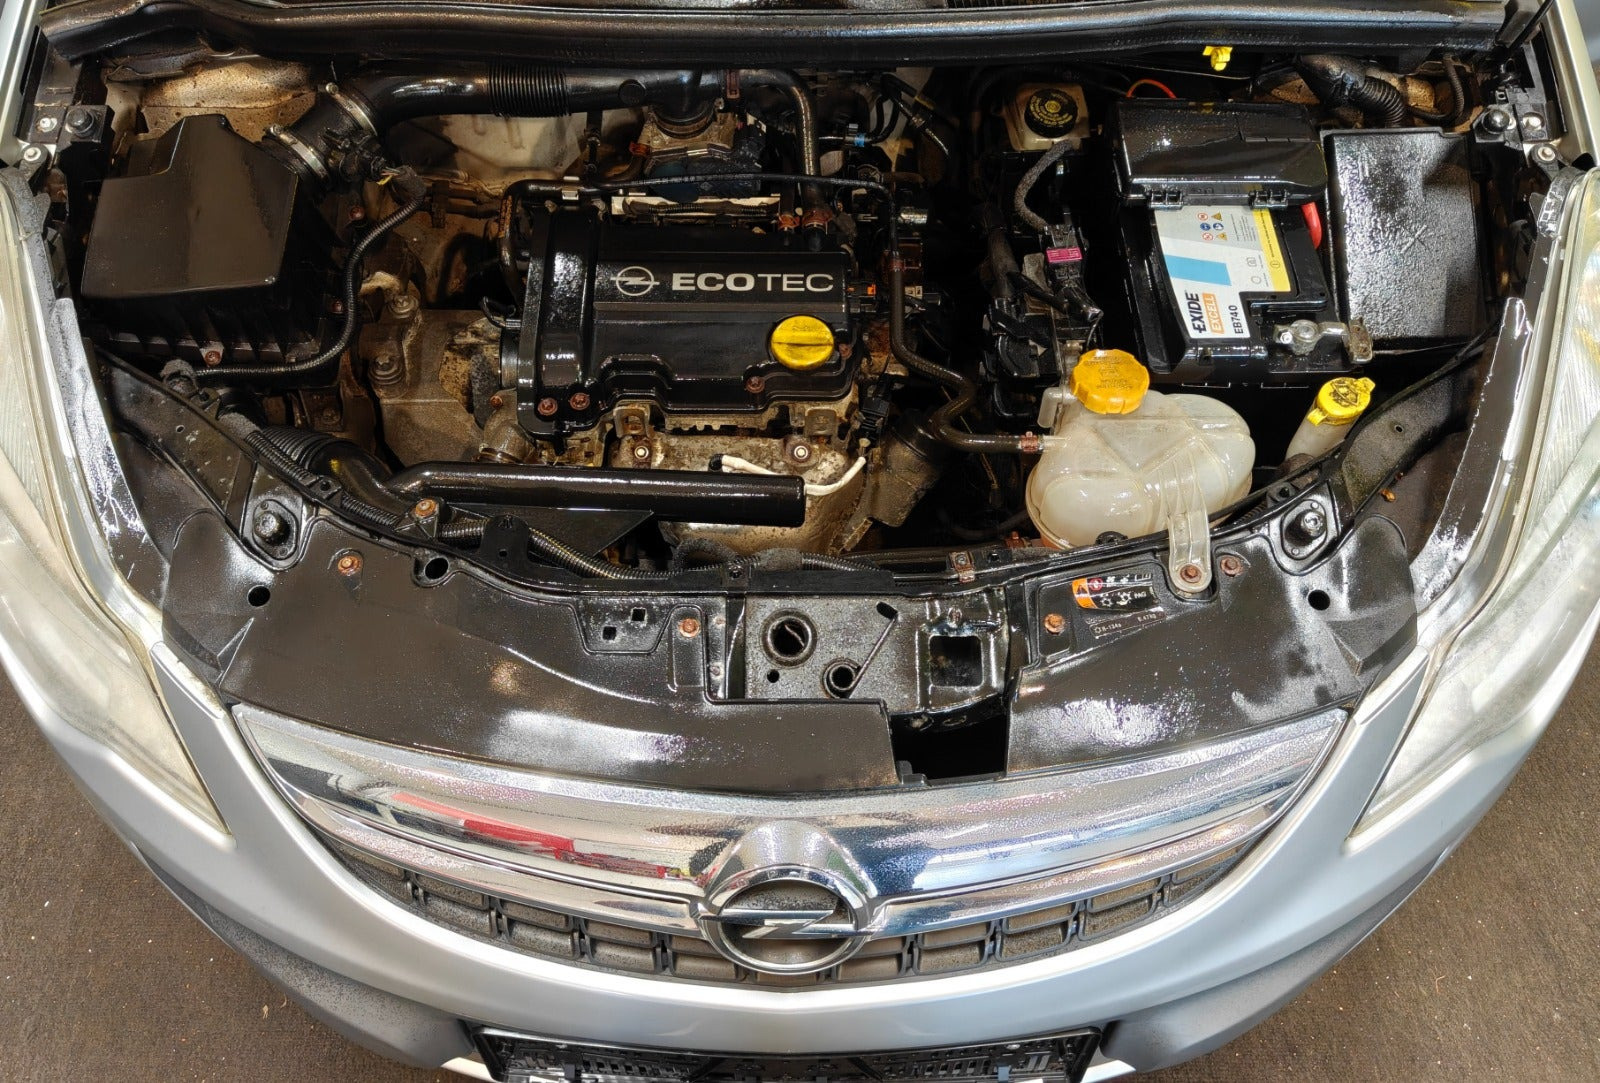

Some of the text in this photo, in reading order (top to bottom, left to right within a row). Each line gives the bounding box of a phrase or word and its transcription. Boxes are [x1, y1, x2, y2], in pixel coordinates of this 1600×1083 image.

[672, 272, 834, 292] ECOTEC
[1185, 291, 1207, 333] EXIDE
[1204, 294, 1223, 332] EXCELL
[1228, 305, 1244, 334] EB740
